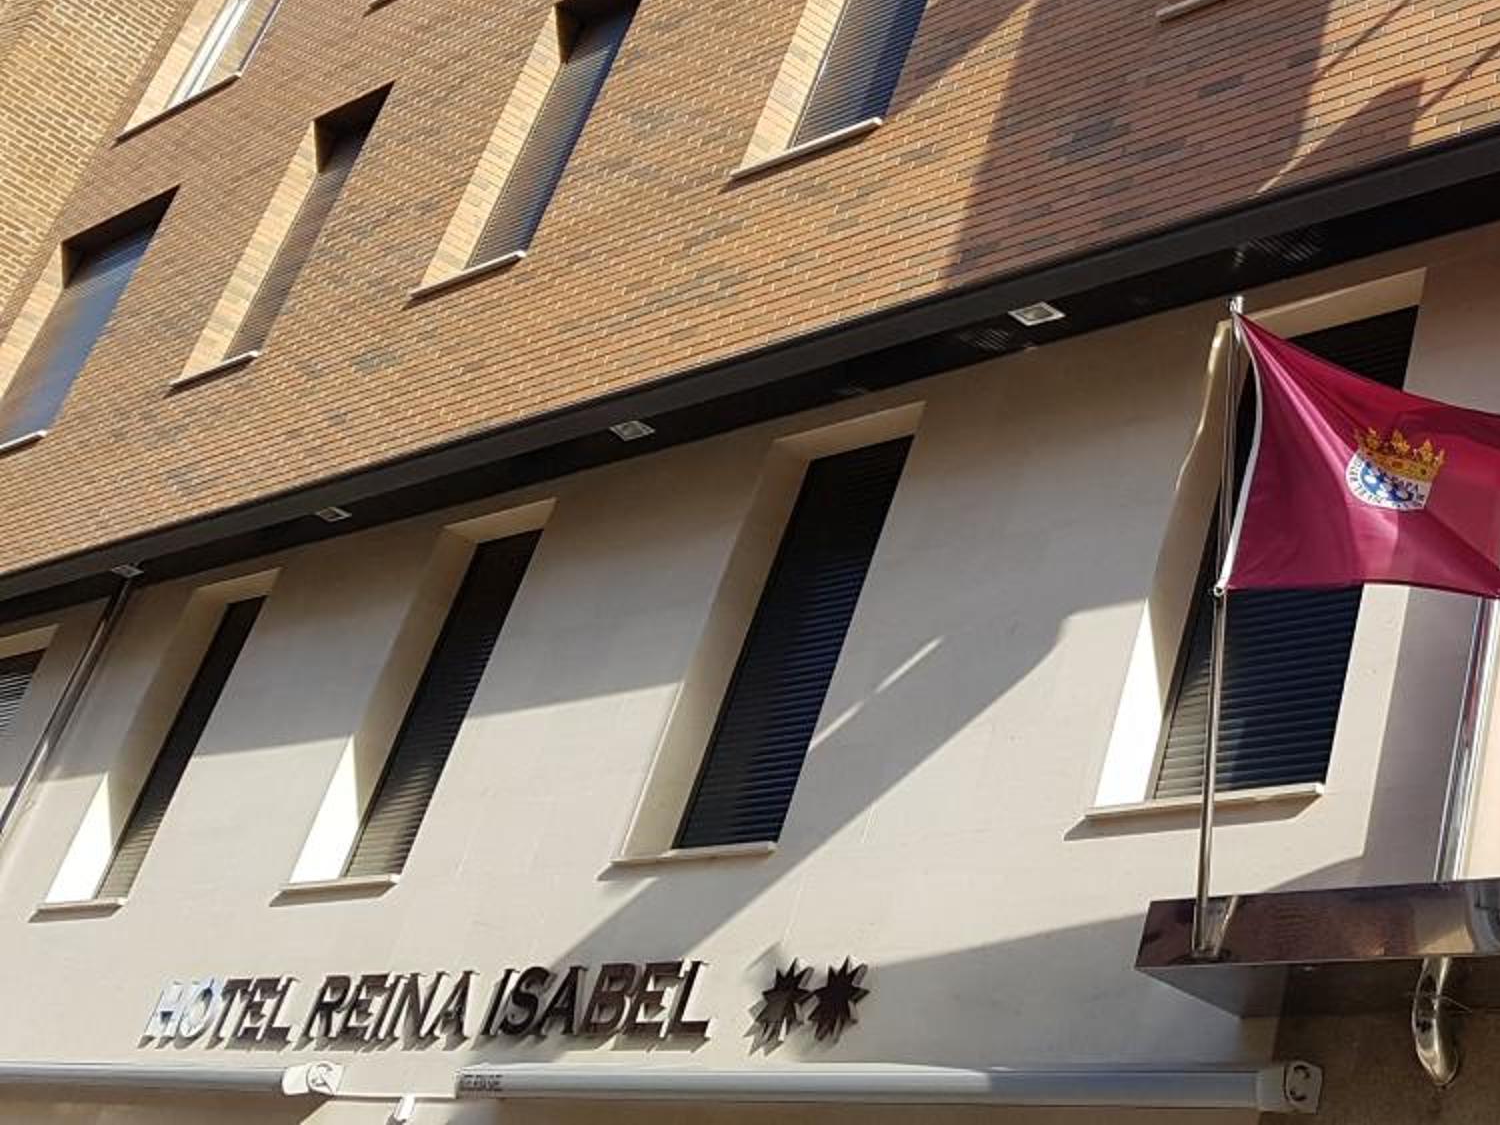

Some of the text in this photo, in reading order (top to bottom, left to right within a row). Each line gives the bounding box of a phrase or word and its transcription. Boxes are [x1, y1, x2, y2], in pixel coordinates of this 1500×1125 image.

[143, 960, 711, 1042] HOTEL REINA ISABEL
